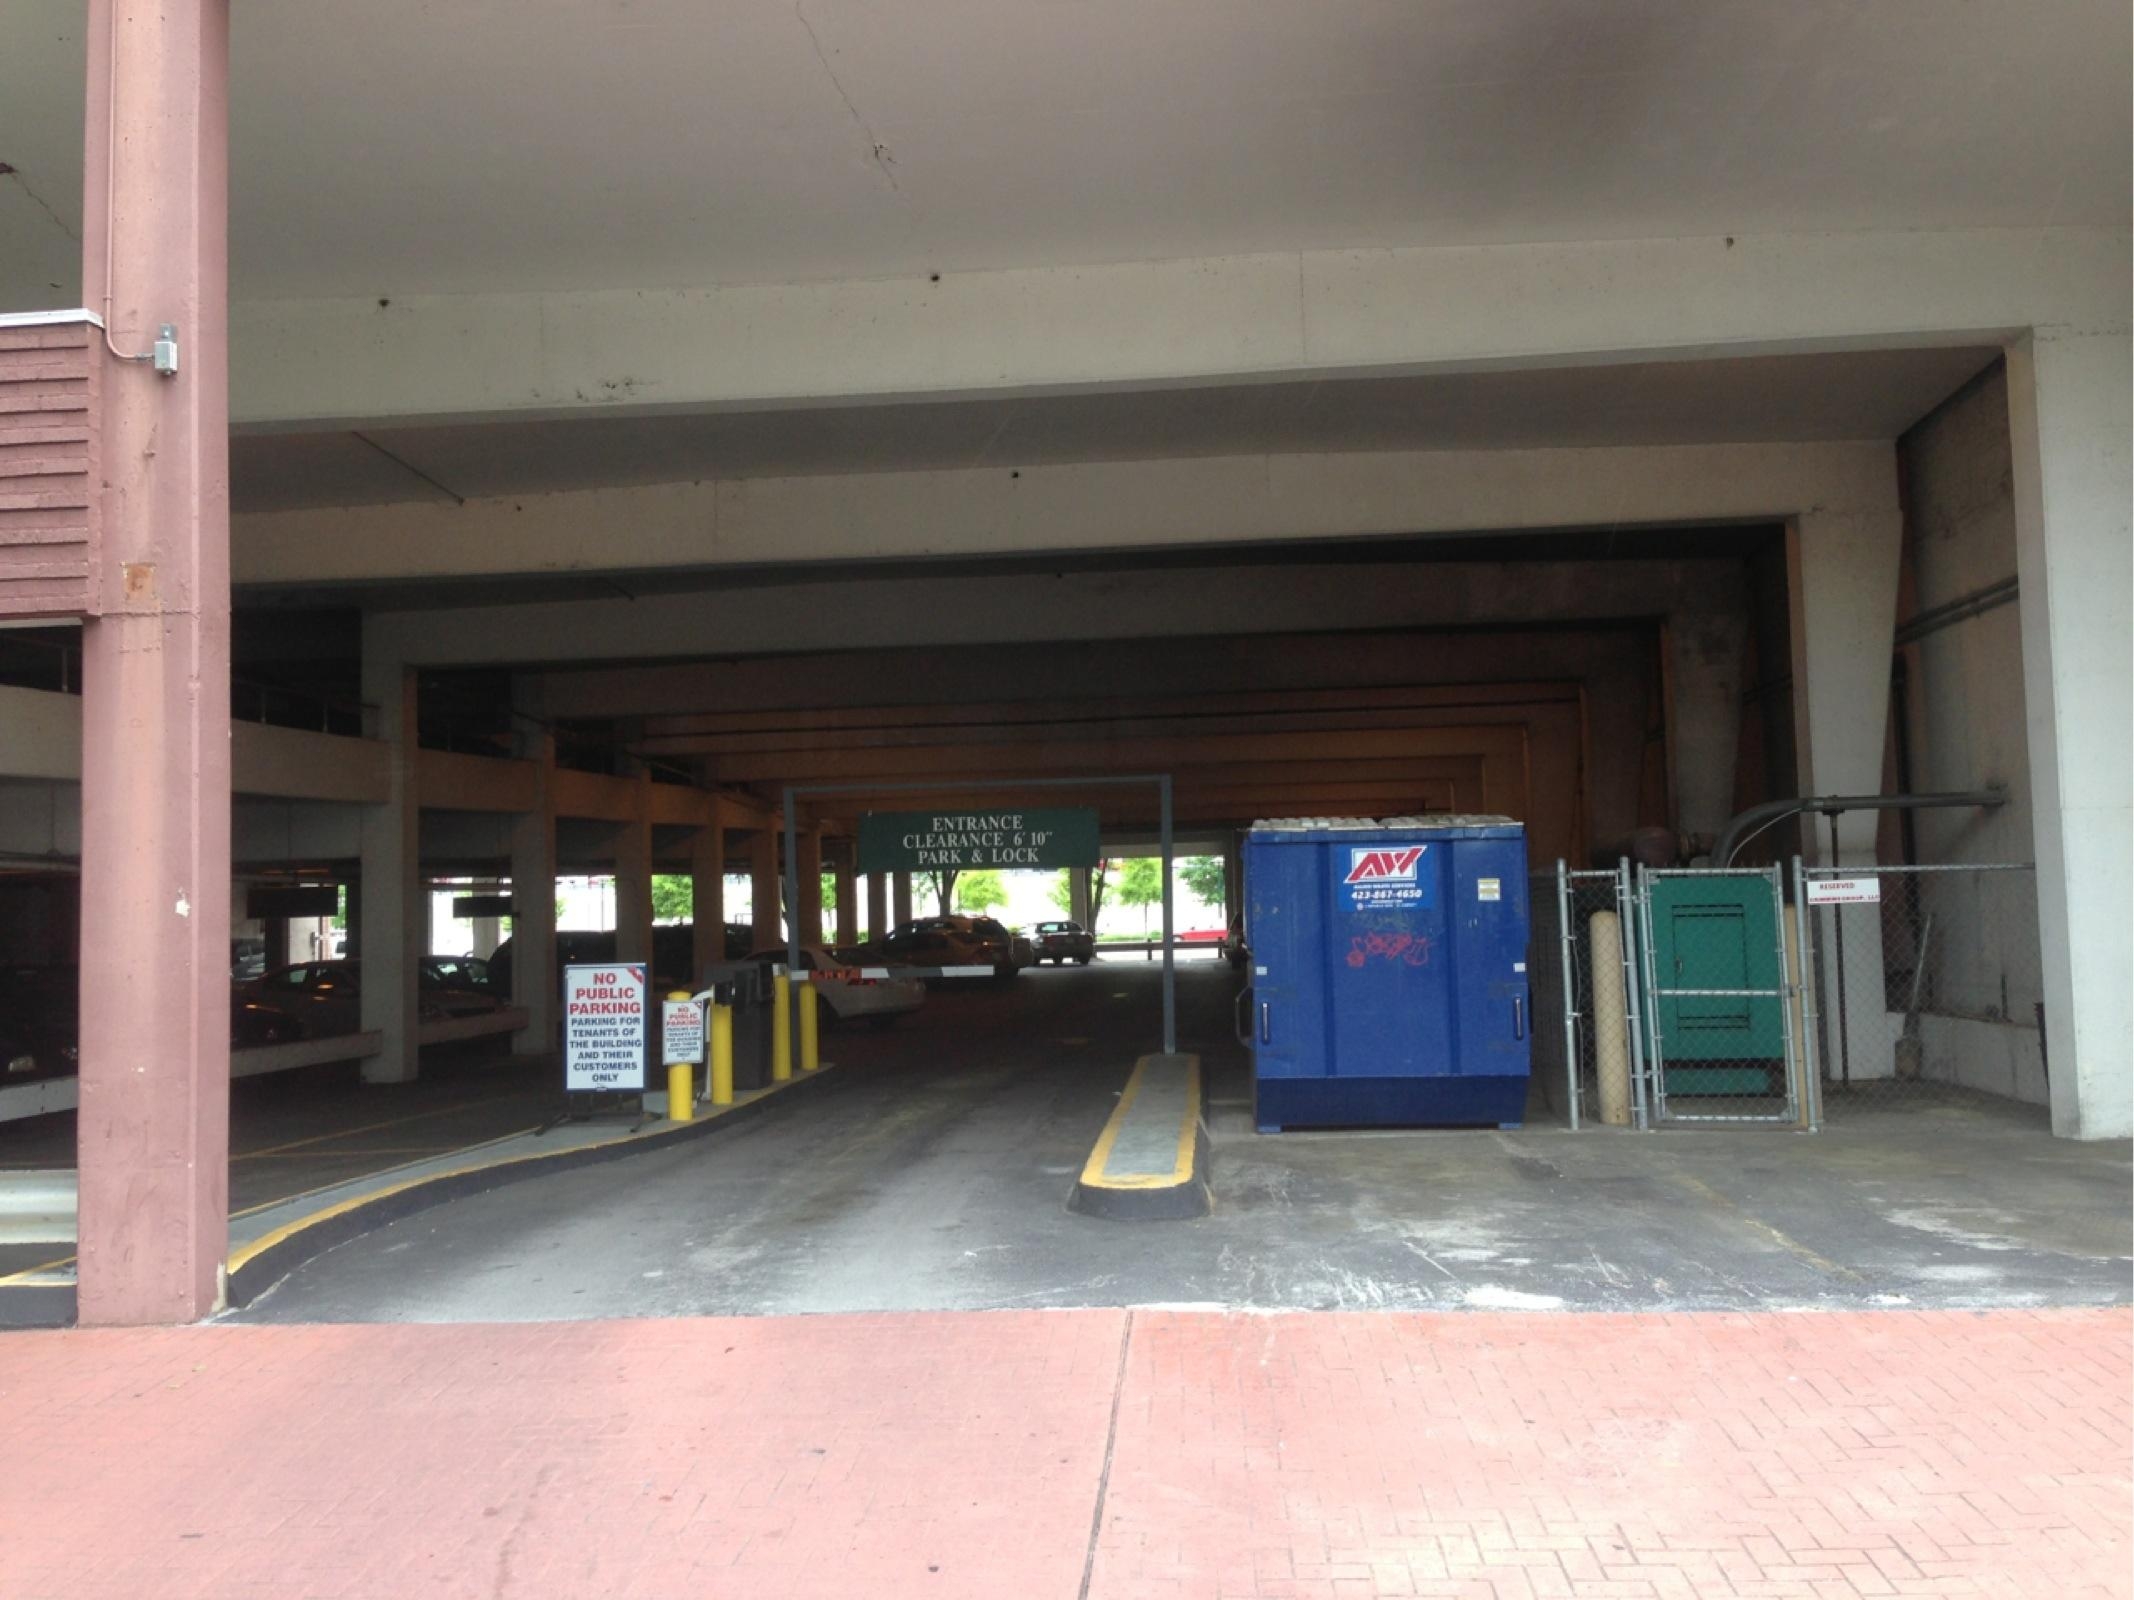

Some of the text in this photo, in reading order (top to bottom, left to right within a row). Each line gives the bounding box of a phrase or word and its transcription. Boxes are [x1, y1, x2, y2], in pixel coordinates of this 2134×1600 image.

[933, 815, 1023, 832] ENTRANCE
[903, 831, 1004, 849] CLEARANCE
[918, 848, 1040, 864] PARK & LOCK
[1819, 882, 1855, 890] RESERVED
[593, 973, 617, 985] NO
[576, 988, 635, 1000] PUBLIC
[569, 1002, 641, 1015] PARKING
[571, 1017, 641, 1026] PARKING FOR
[572, 1029, 636, 1037] TENANTS OF
[570, 1040, 642, 1048] THE BUILDING
[578, 1051, 633, 1059] AND THEIR
[573, 1063, 638, 1071] CUSTOMERS
[592, 1074, 619, 1082] ONLY
